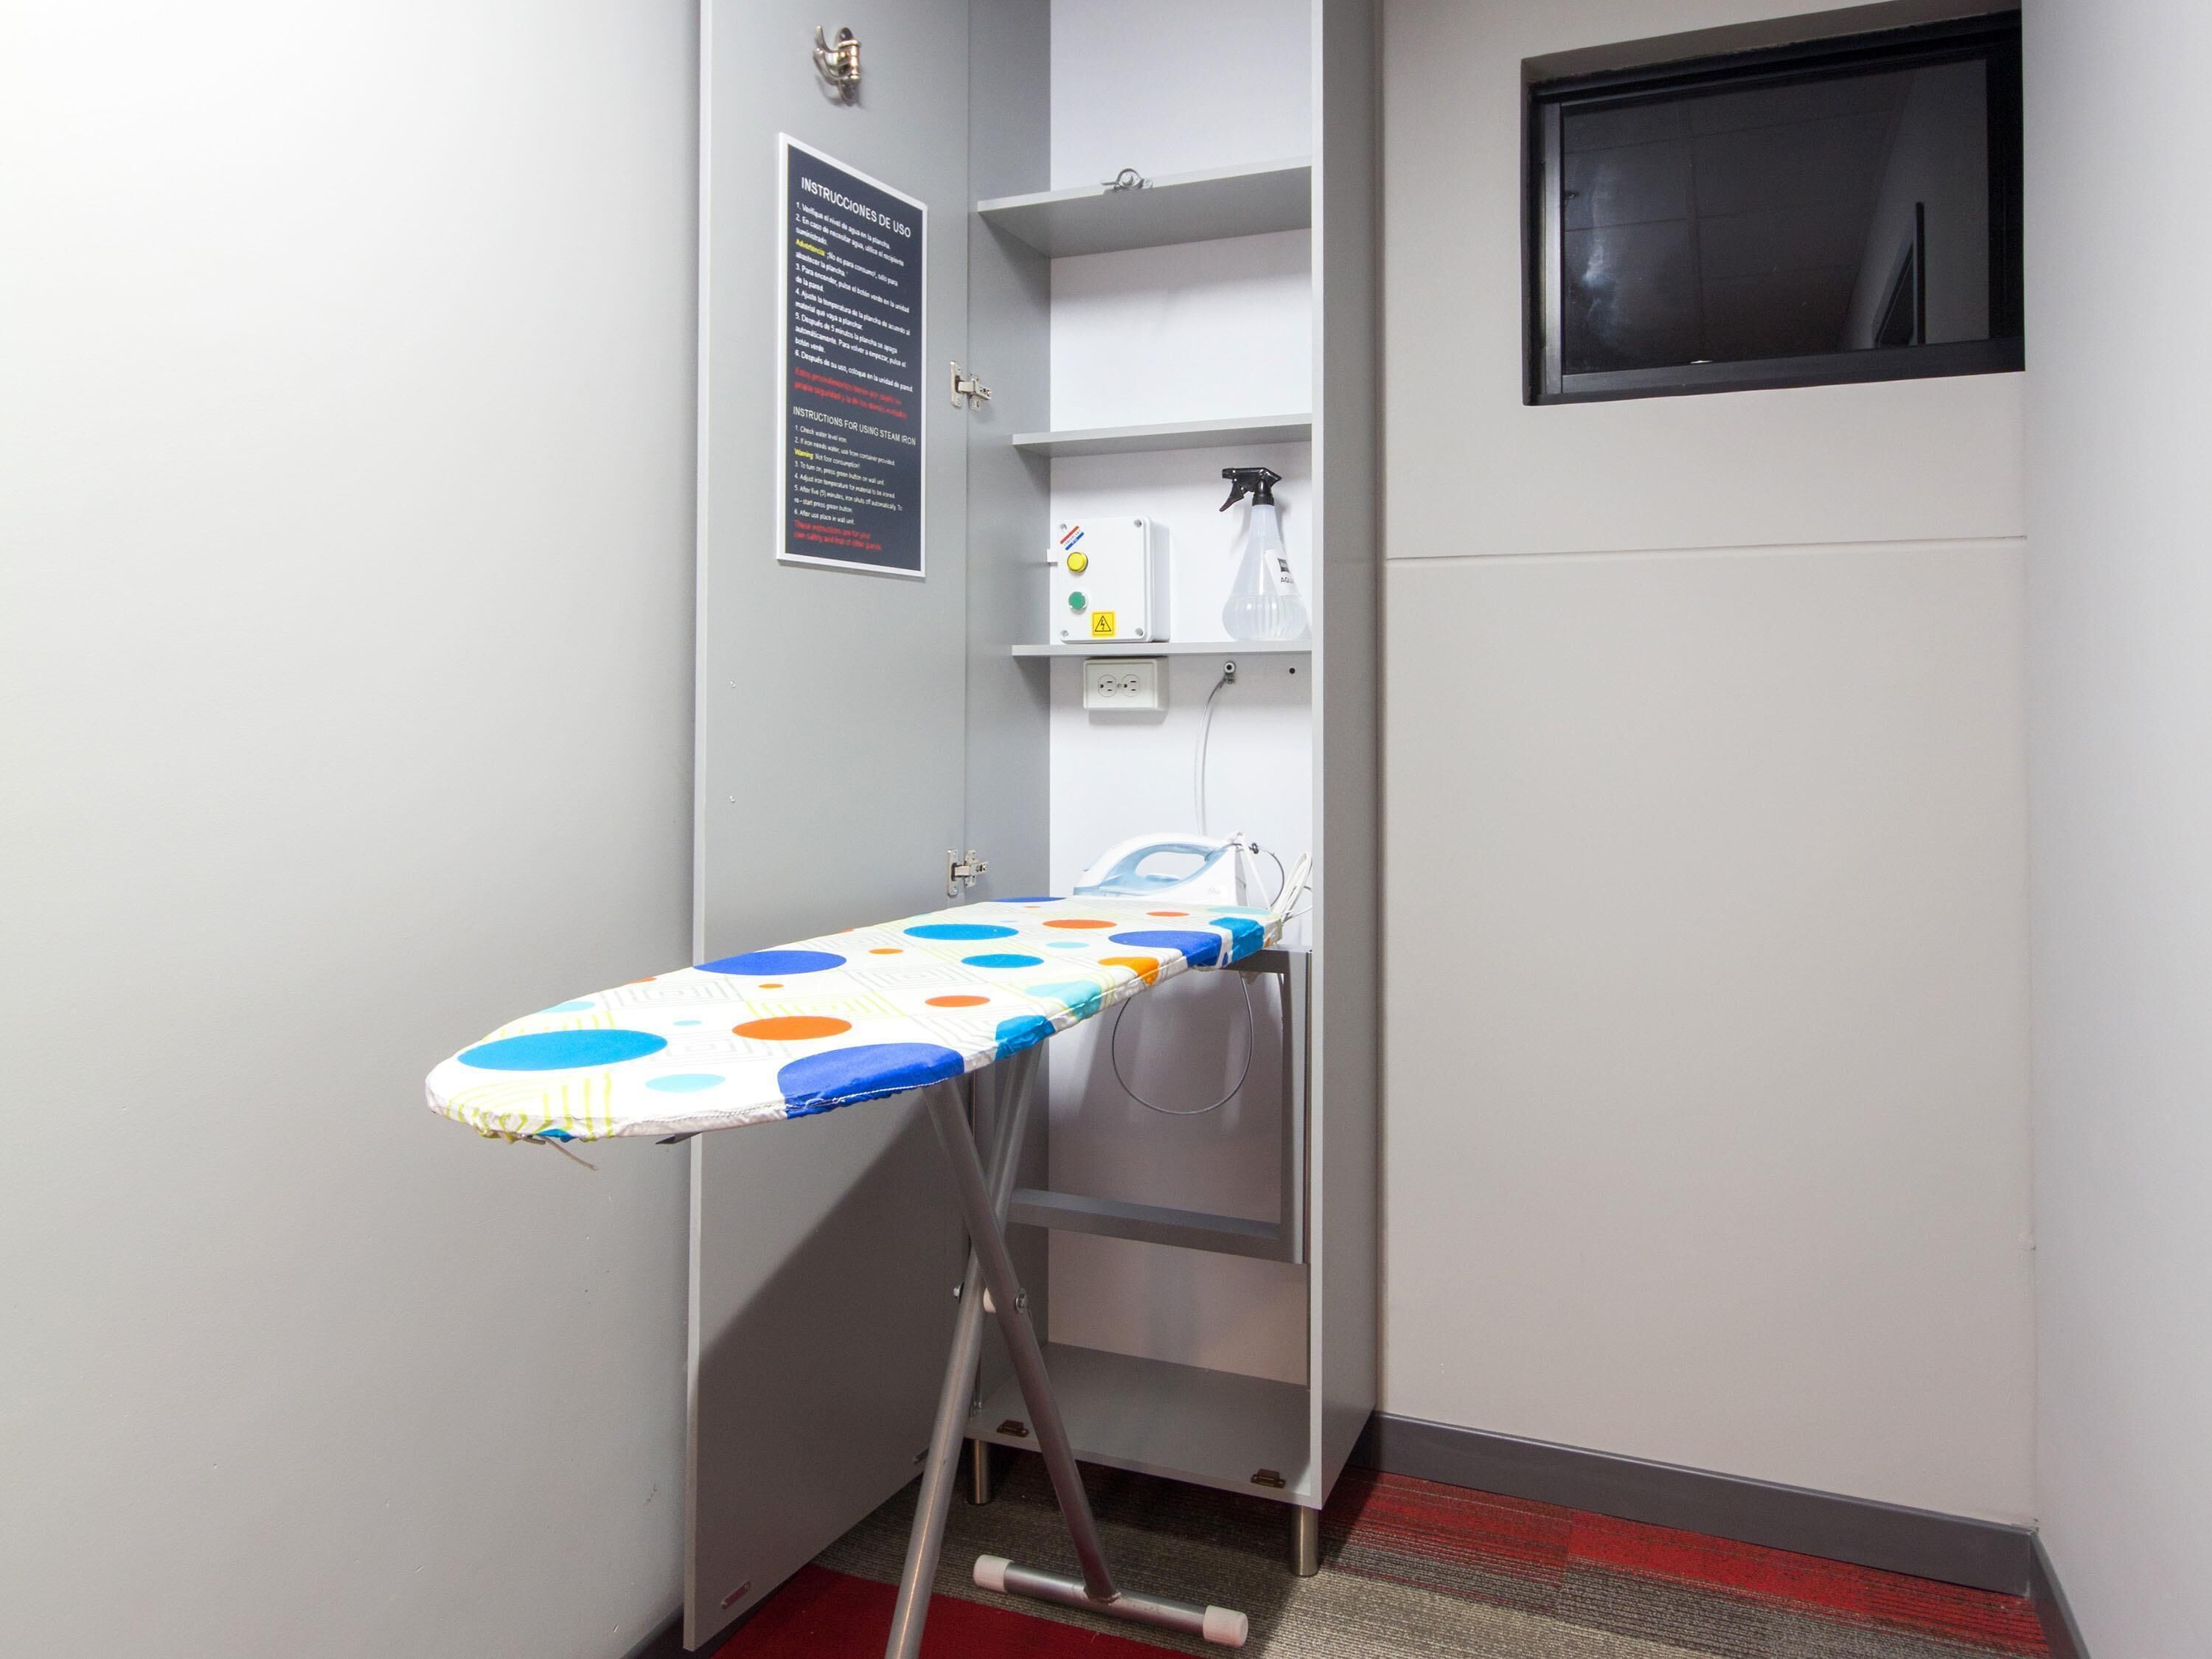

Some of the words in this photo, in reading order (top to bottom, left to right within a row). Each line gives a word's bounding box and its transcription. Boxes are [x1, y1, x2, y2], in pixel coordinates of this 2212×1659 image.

[801, 178, 877, 221] INSTRUCCIONES
[879, 214, 891, 229] DE
[893, 221, 911, 237] USO
[801, 265, 814, 276] Para
[838, 339, 850, 349] Para
[793, 407, 843, 426] INSTRUCTIONS
[844, 420, 858, 431] FOR
[859, 425, 878, 436] USING
[880, 430, 900, 441] STEAM
[902, 436, 916, 445] IRON
